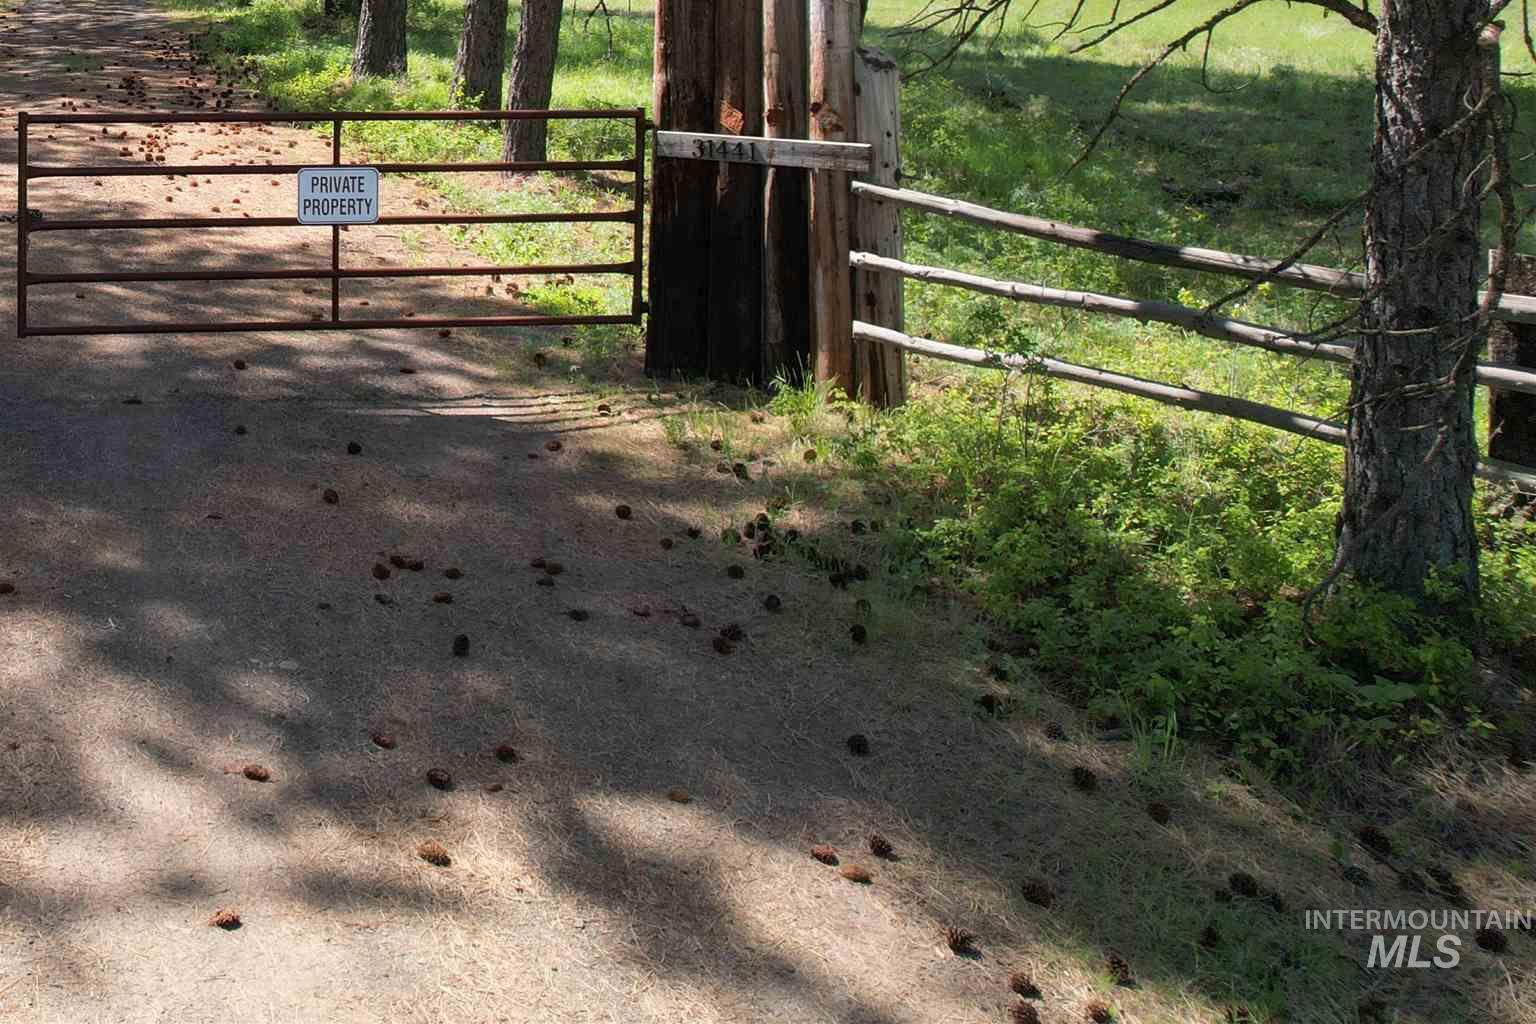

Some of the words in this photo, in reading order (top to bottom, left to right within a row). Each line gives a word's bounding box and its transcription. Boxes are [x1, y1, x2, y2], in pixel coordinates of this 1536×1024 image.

[692, 139, 755, 160] 31441
[311, 176, 365, 193] PRIVATE
[303, 198, 373, 215] PROPERTY
